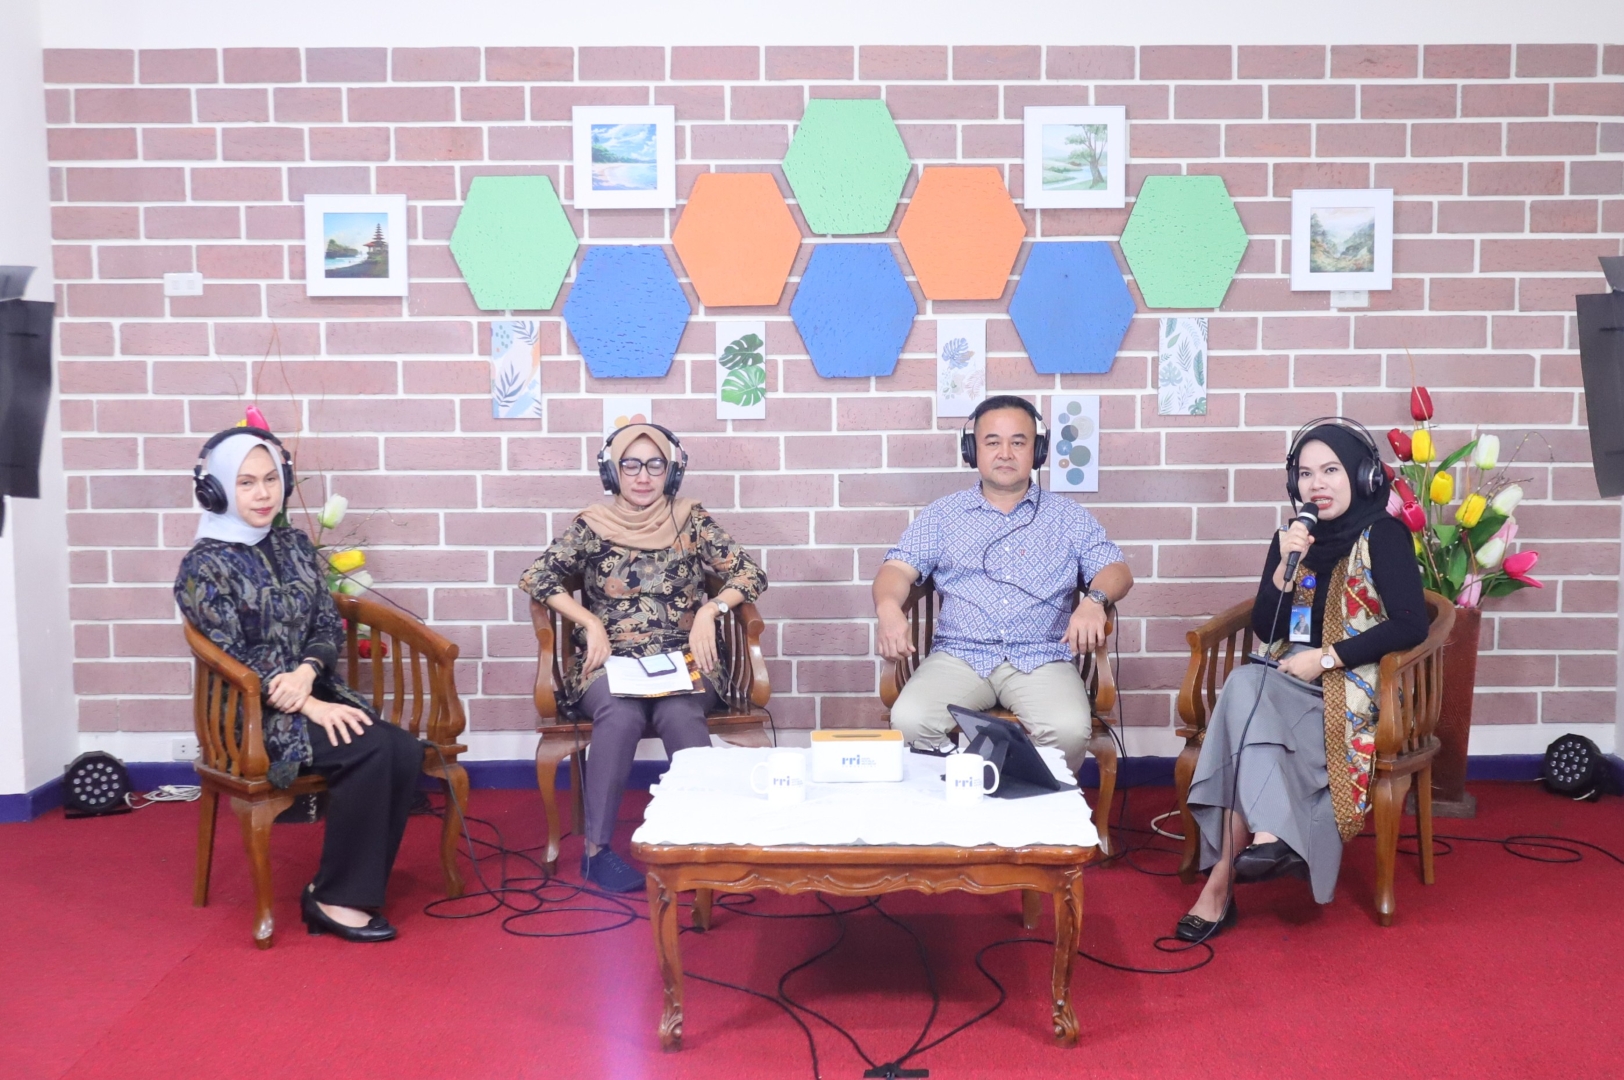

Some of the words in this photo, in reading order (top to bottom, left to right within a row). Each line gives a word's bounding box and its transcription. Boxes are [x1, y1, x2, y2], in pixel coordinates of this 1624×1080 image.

[842, 754, 860, 765] rri
[773, 775, 790, 786] rri
[955, 776, 972, 787] rri
